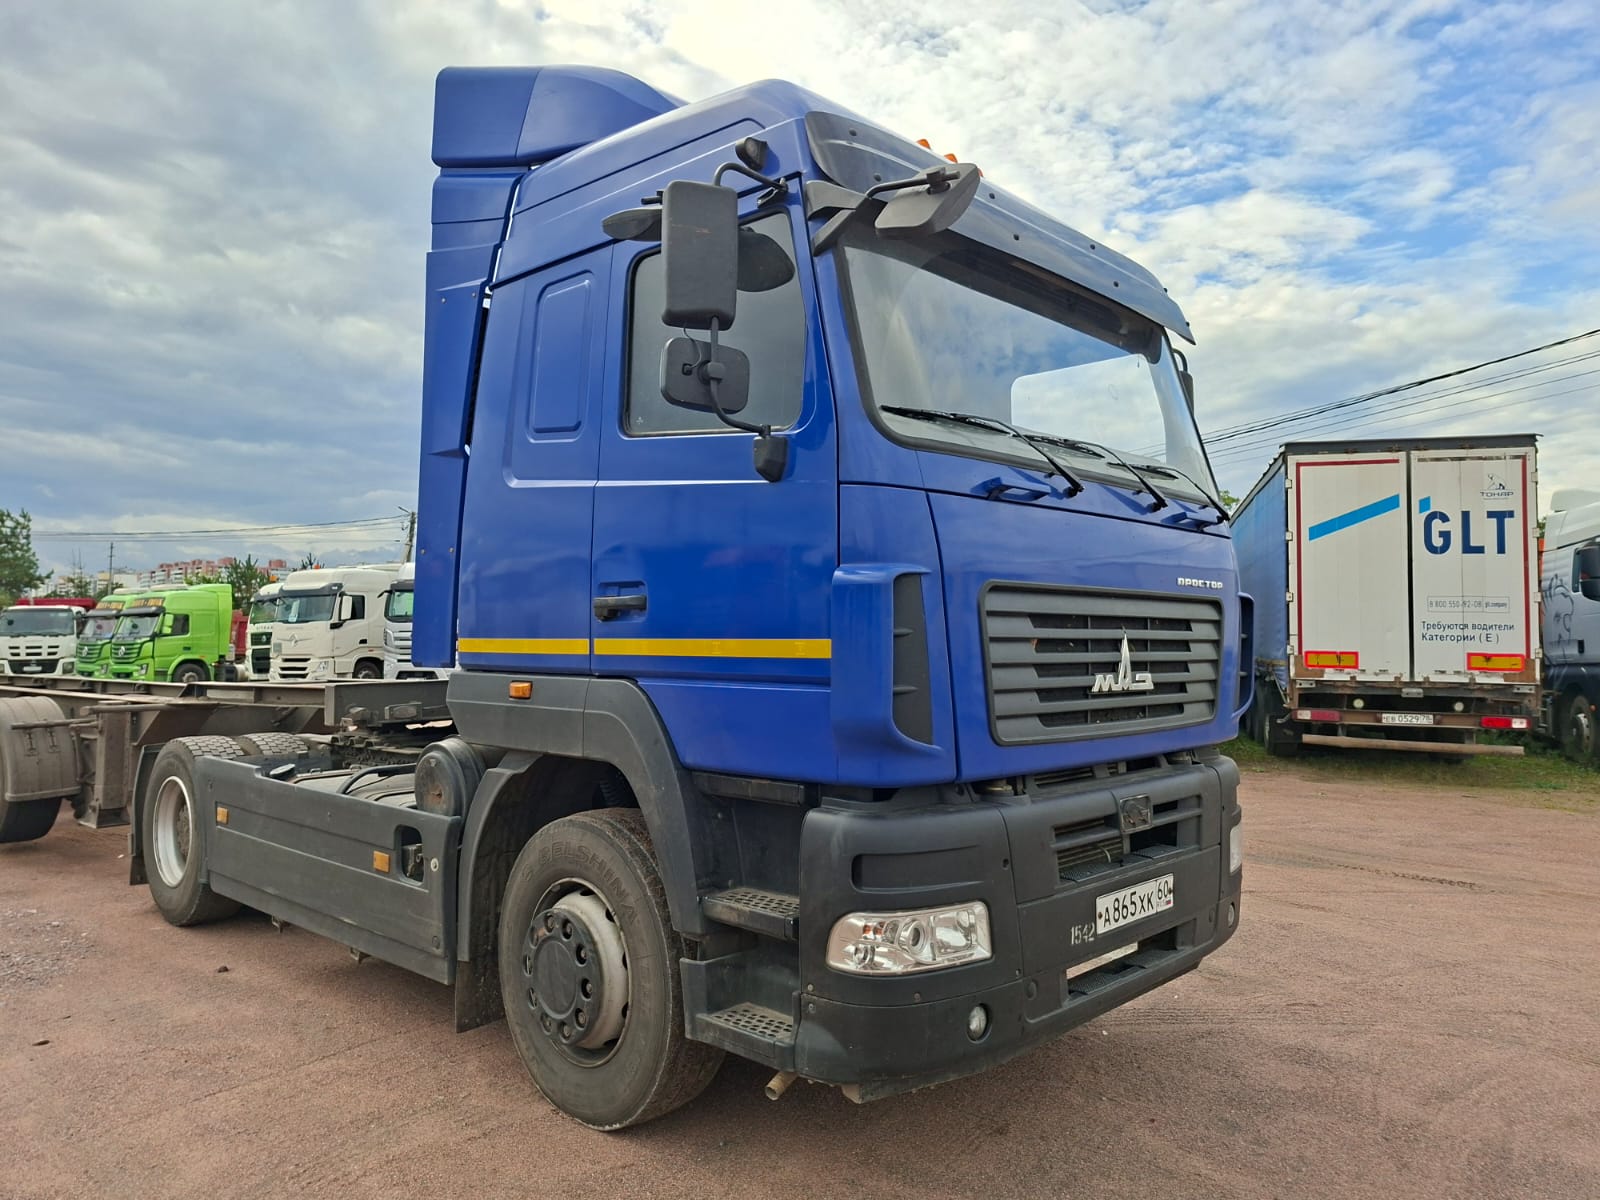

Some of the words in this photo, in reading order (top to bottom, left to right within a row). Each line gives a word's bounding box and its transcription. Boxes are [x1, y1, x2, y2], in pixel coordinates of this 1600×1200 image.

[1423, 510, 1515, 554] GLT
[1177, 577, 1224, 589] ПРОСТОР
[1421, 621, 1469, 632] Требуются
[1471, 623, 1515, 631] водители
[1421, 632, 1476, 643] Категории
[538, 841, 639, 924] BELSHINA
[1157, 880, 1169, 900] 60
[1070, 922, 1096, 946] 1542
